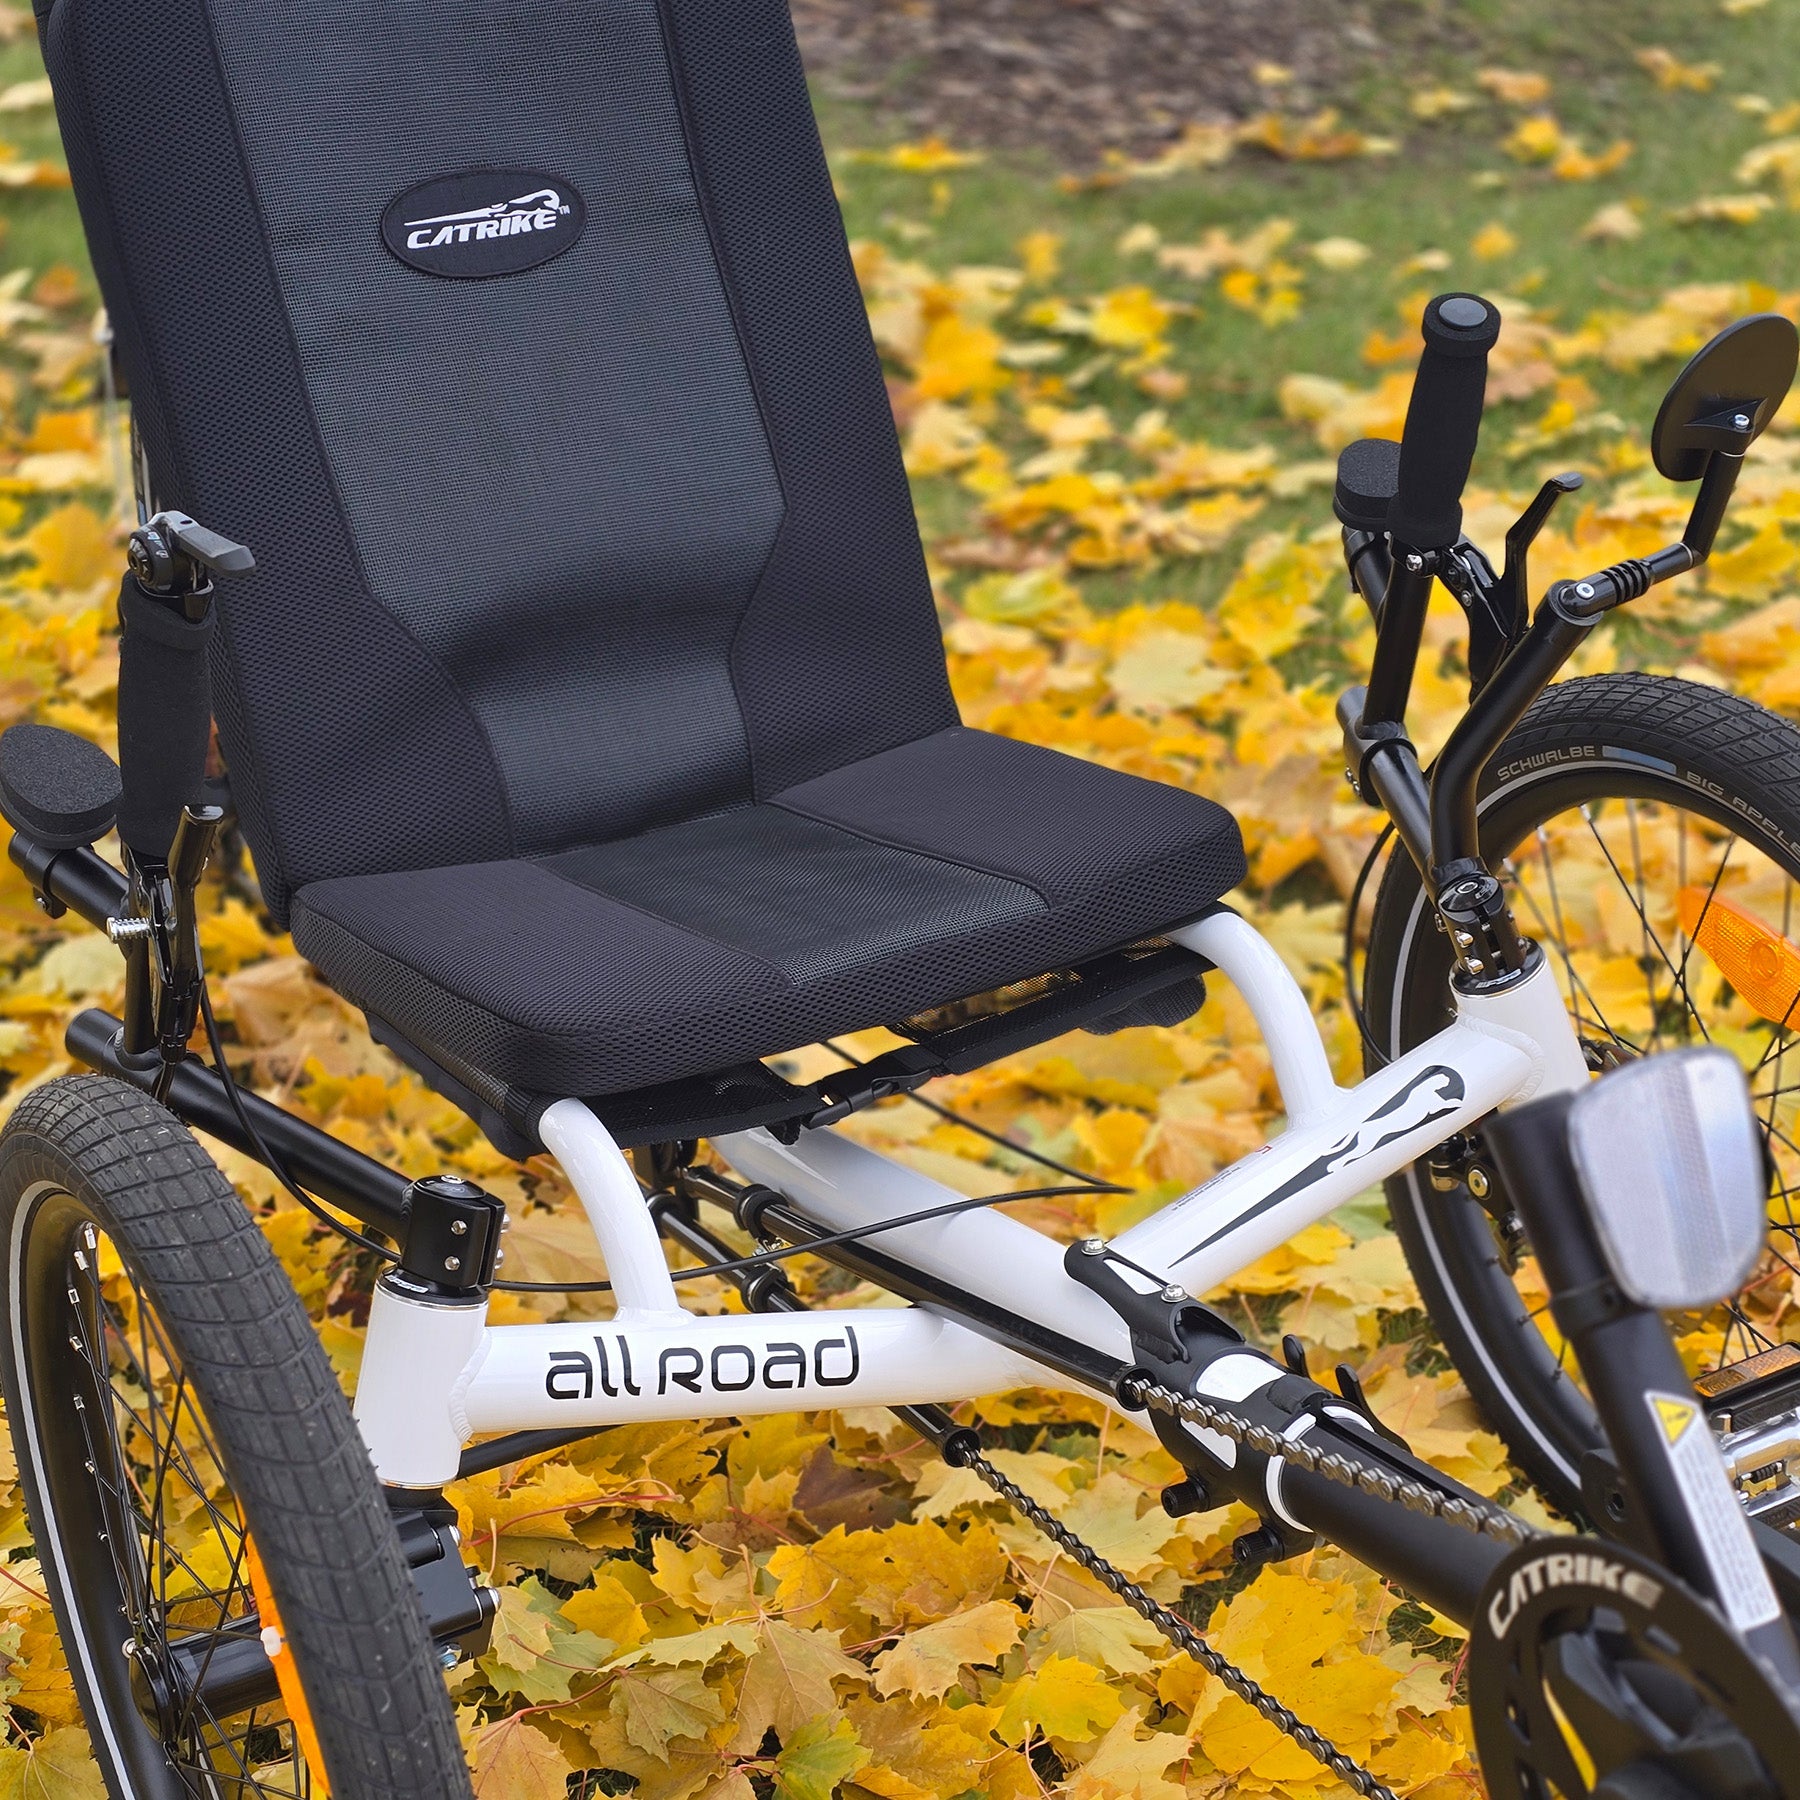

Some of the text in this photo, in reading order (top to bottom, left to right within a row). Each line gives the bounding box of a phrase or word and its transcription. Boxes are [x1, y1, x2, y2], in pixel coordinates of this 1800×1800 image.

[406, 210, 557, 249] CATRIKE
[1497, 745, 1595, 782] SCHWALBE
[1686, 771, 1725, 796] BIG
[545, 1334, 642, 1400] all
[1488, 1553, 1663, 1640] CATRIKE
